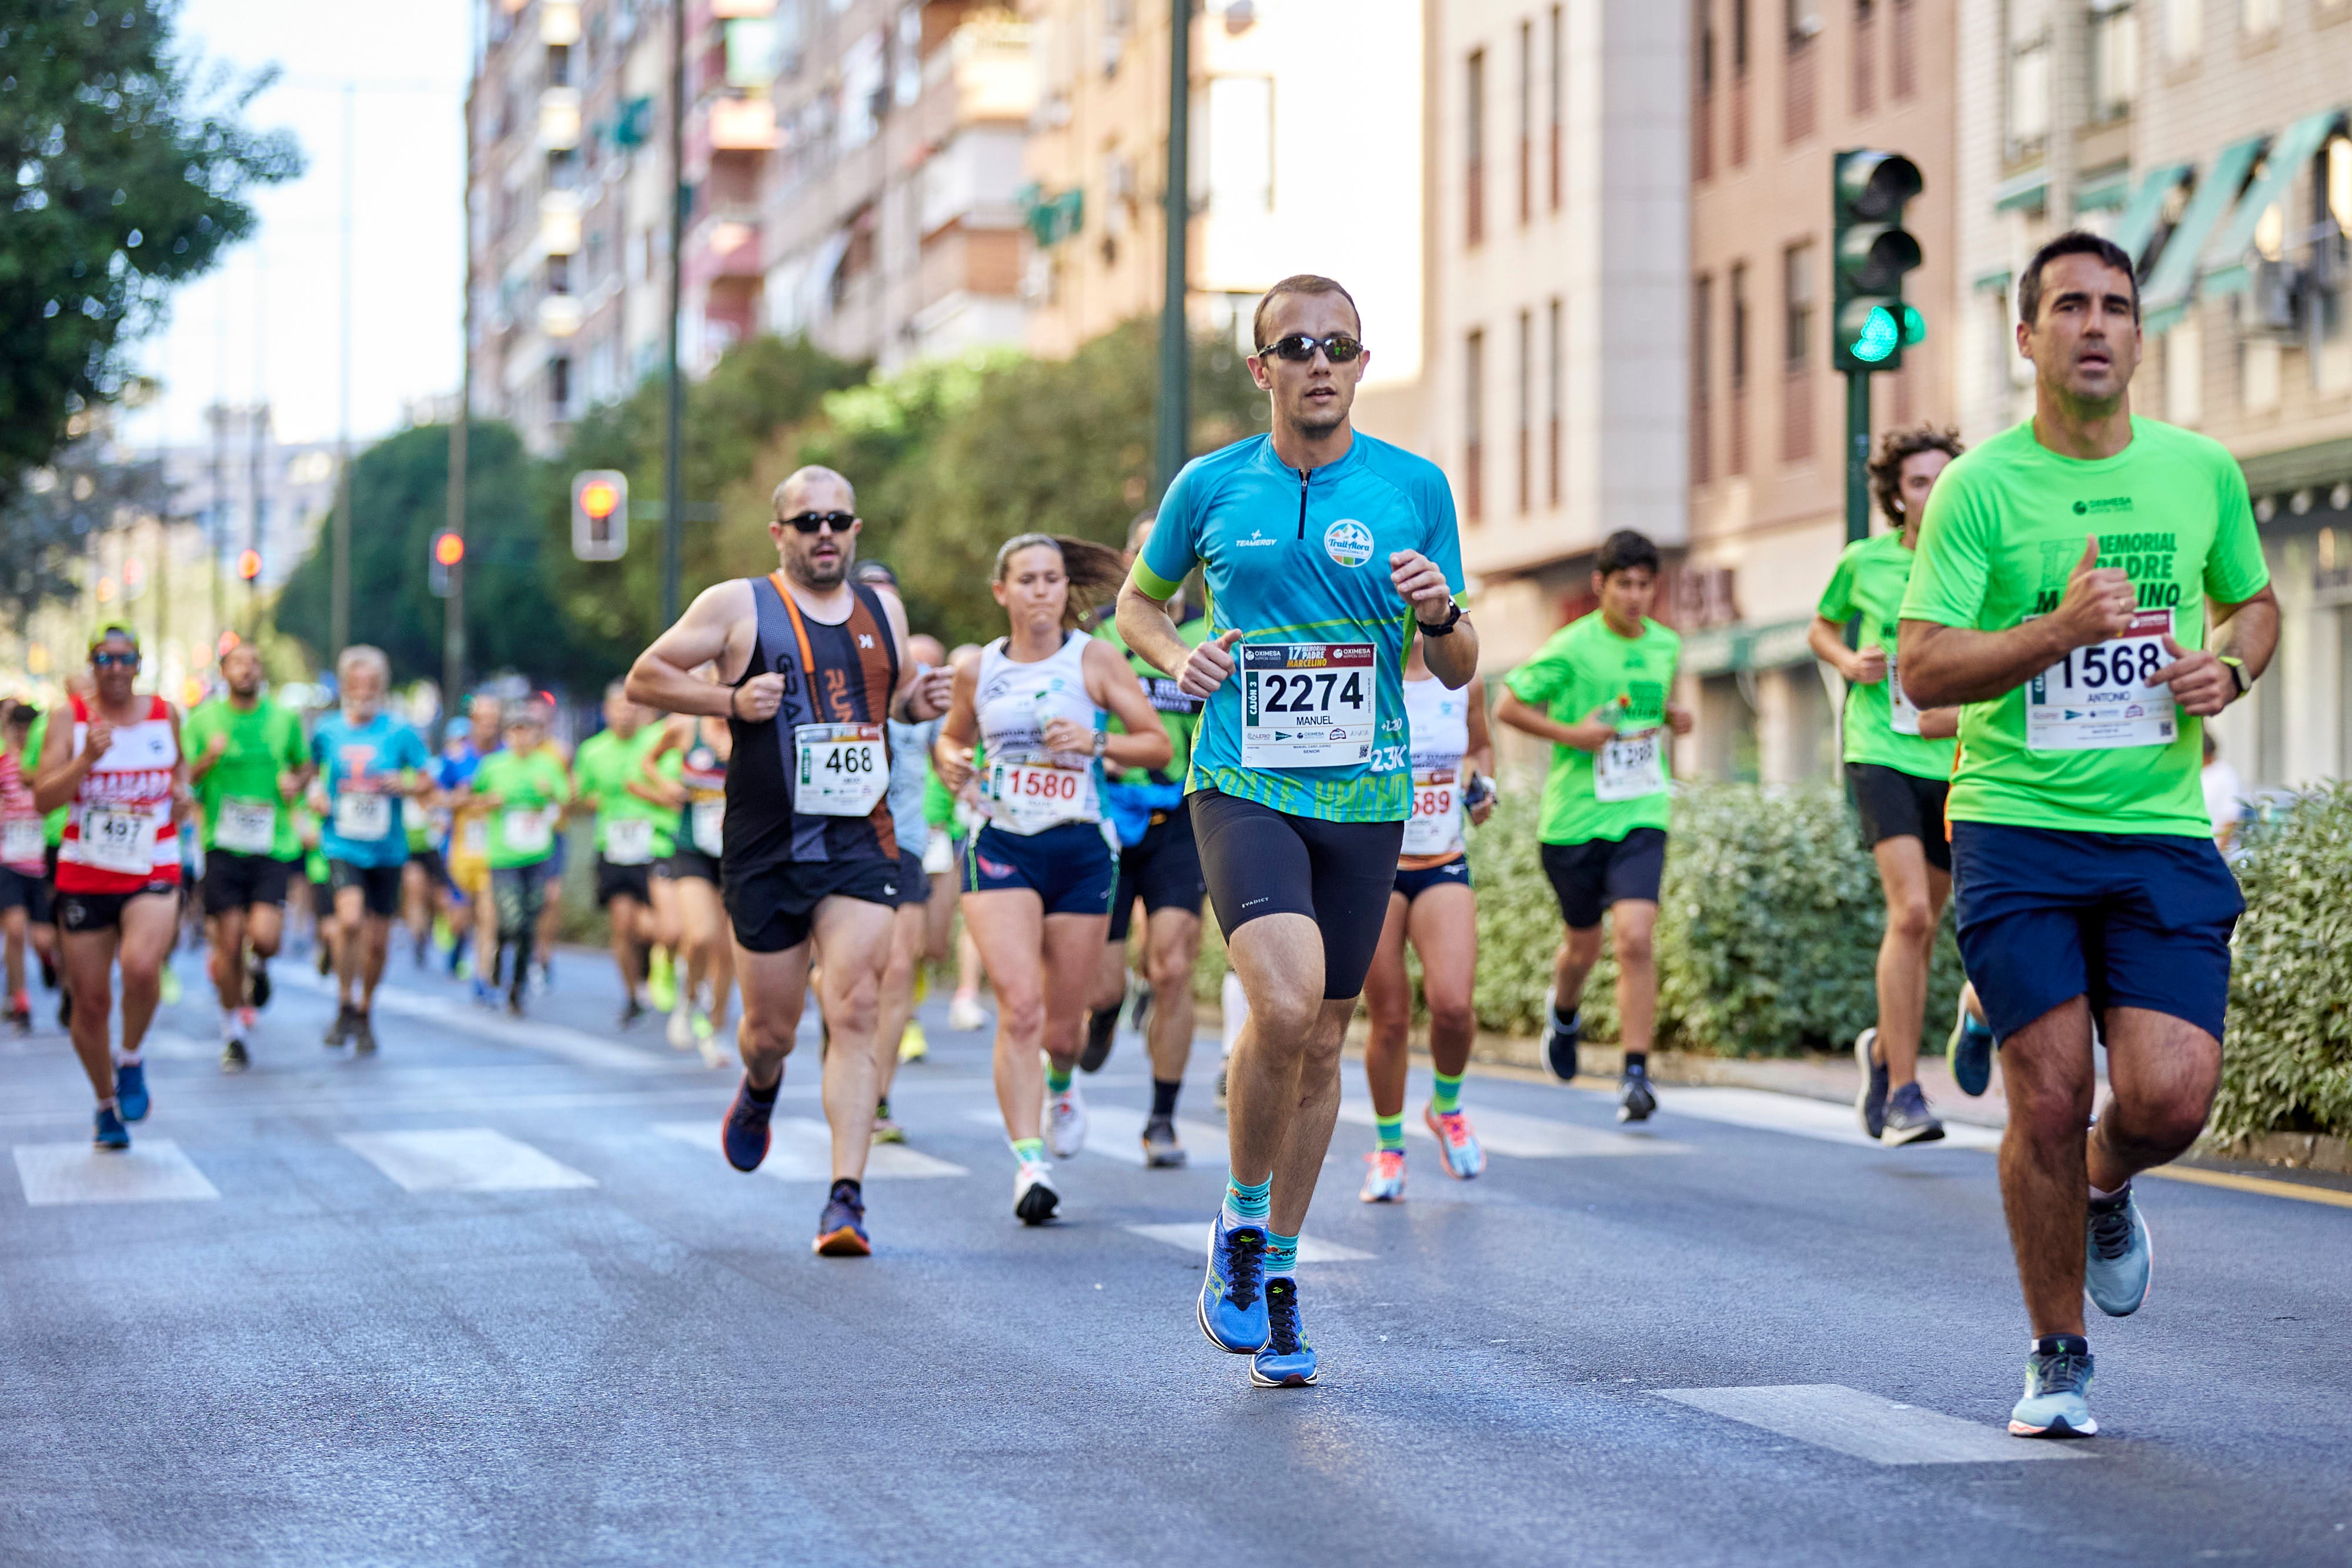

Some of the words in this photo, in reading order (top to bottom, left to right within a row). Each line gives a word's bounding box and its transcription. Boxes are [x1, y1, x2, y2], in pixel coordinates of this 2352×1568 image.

[1236, 539, 1277, 547] TEAMERGY
[1329, 539, 1348, 548] Trail
[2098, 532, 2177, 554] MEMORIAL
[1288, 646, 1302, 660] 17
[1302, 651, 1325, 660] PADRE
[1287, 658, 1327, 668] MARCELINO
[2059, 643, 2161, 688] 1568
[1265, 672, 1364, 712] 2274
[2087, 691, 2131, 704] ANTONIO
[1248, 689, 1257, 715] CAJÓN
[1297, 716, 1333, 726] MANUEL
[826, 747, 873, 773] 468
[1371, 744, 1407, 772] 23K
[1009, 769, 1076, 800] 1580
